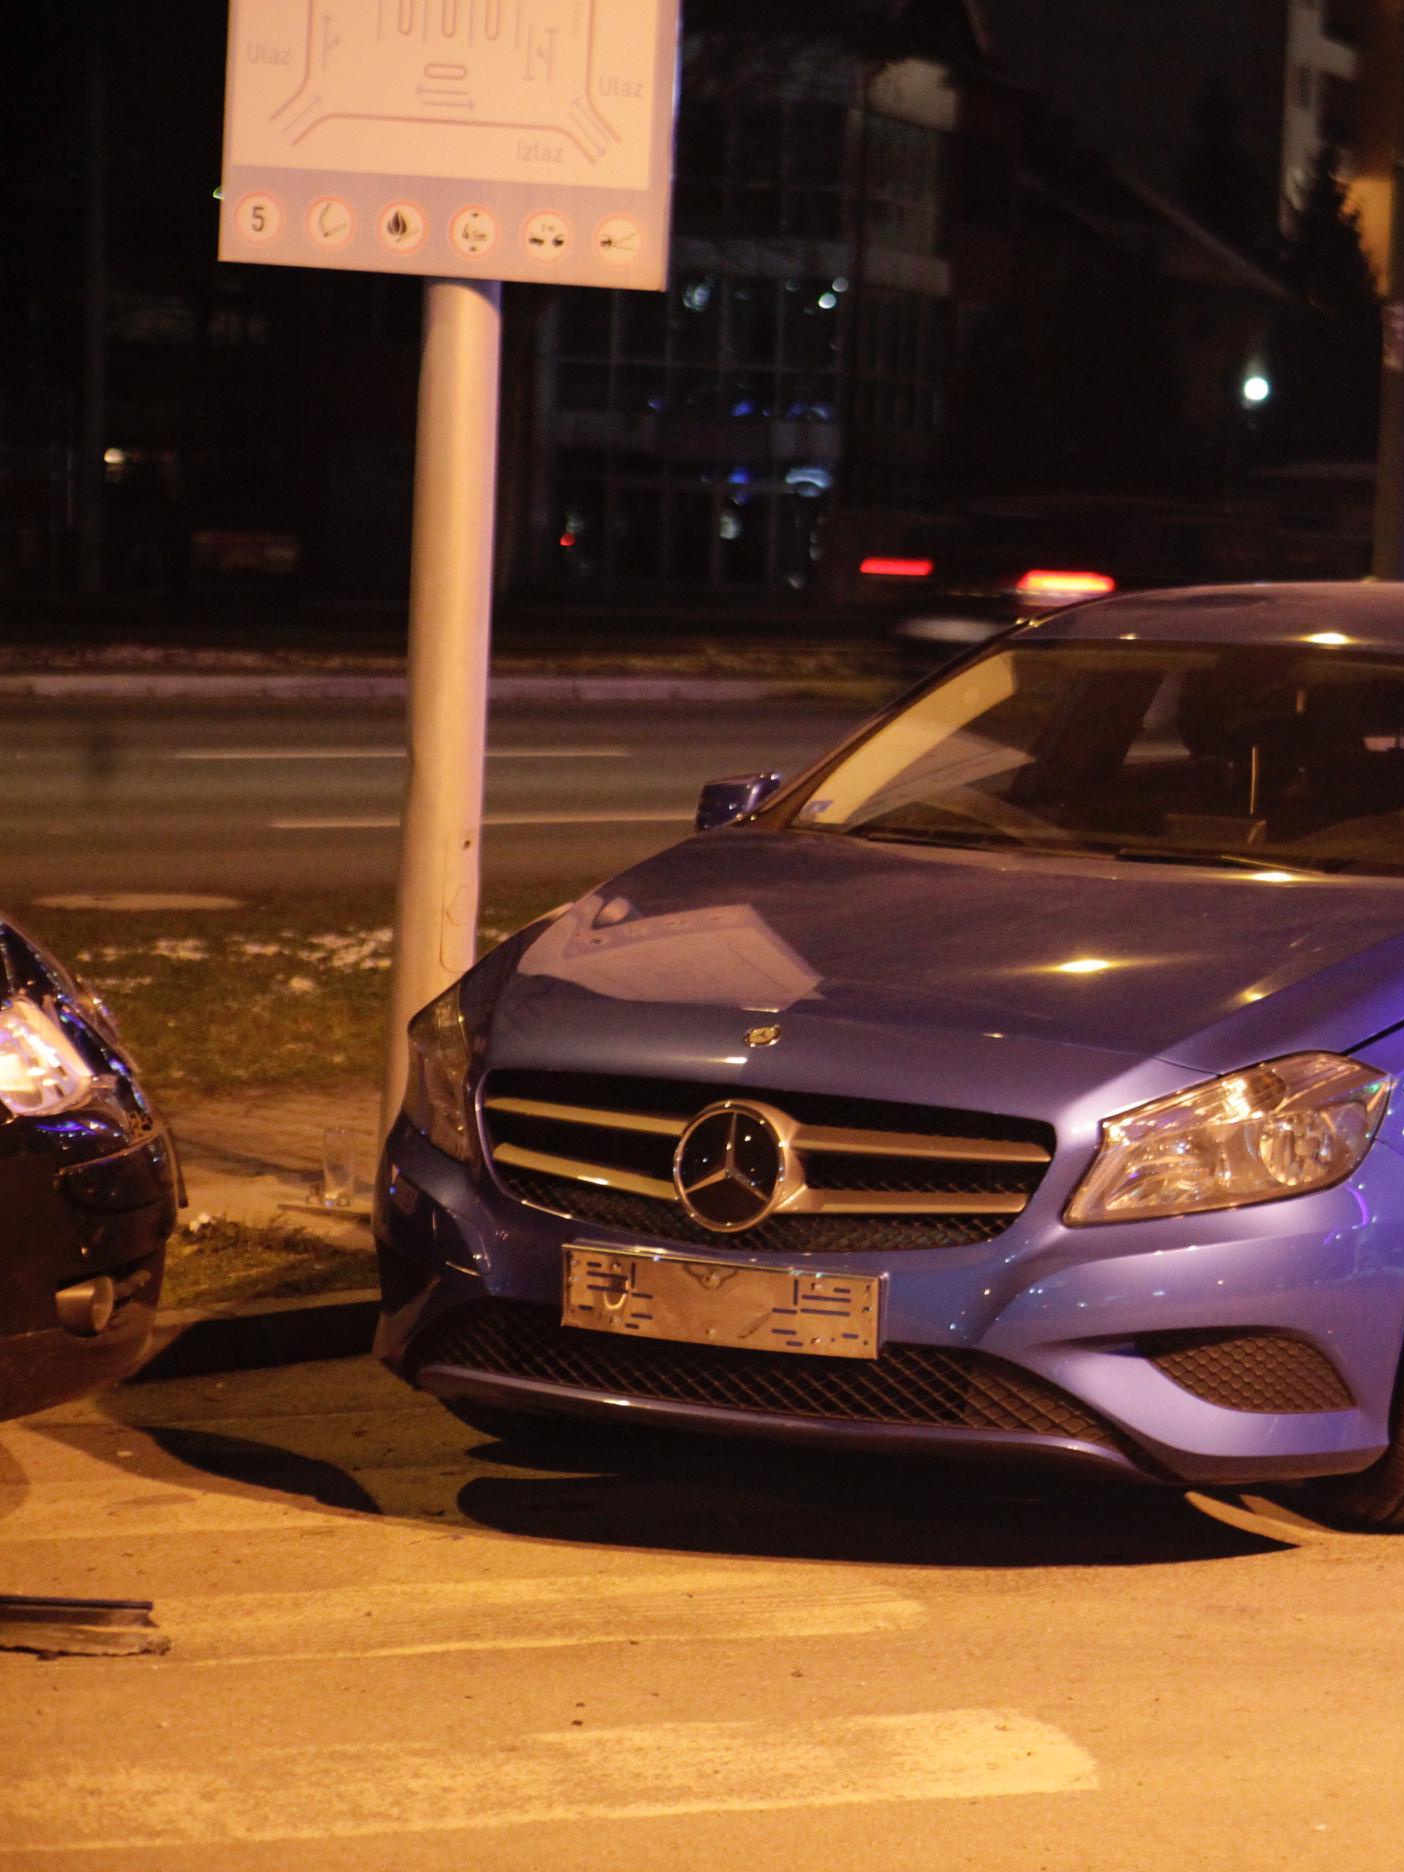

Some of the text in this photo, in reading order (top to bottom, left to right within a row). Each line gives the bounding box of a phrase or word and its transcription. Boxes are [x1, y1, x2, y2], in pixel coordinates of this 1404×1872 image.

[246, 42, 291, 66] Ulaz
[598, 75, 643, 98] Ulaz
[516, 140, 564, 163] Izlaz
[252, 205, 265, 232] 5
